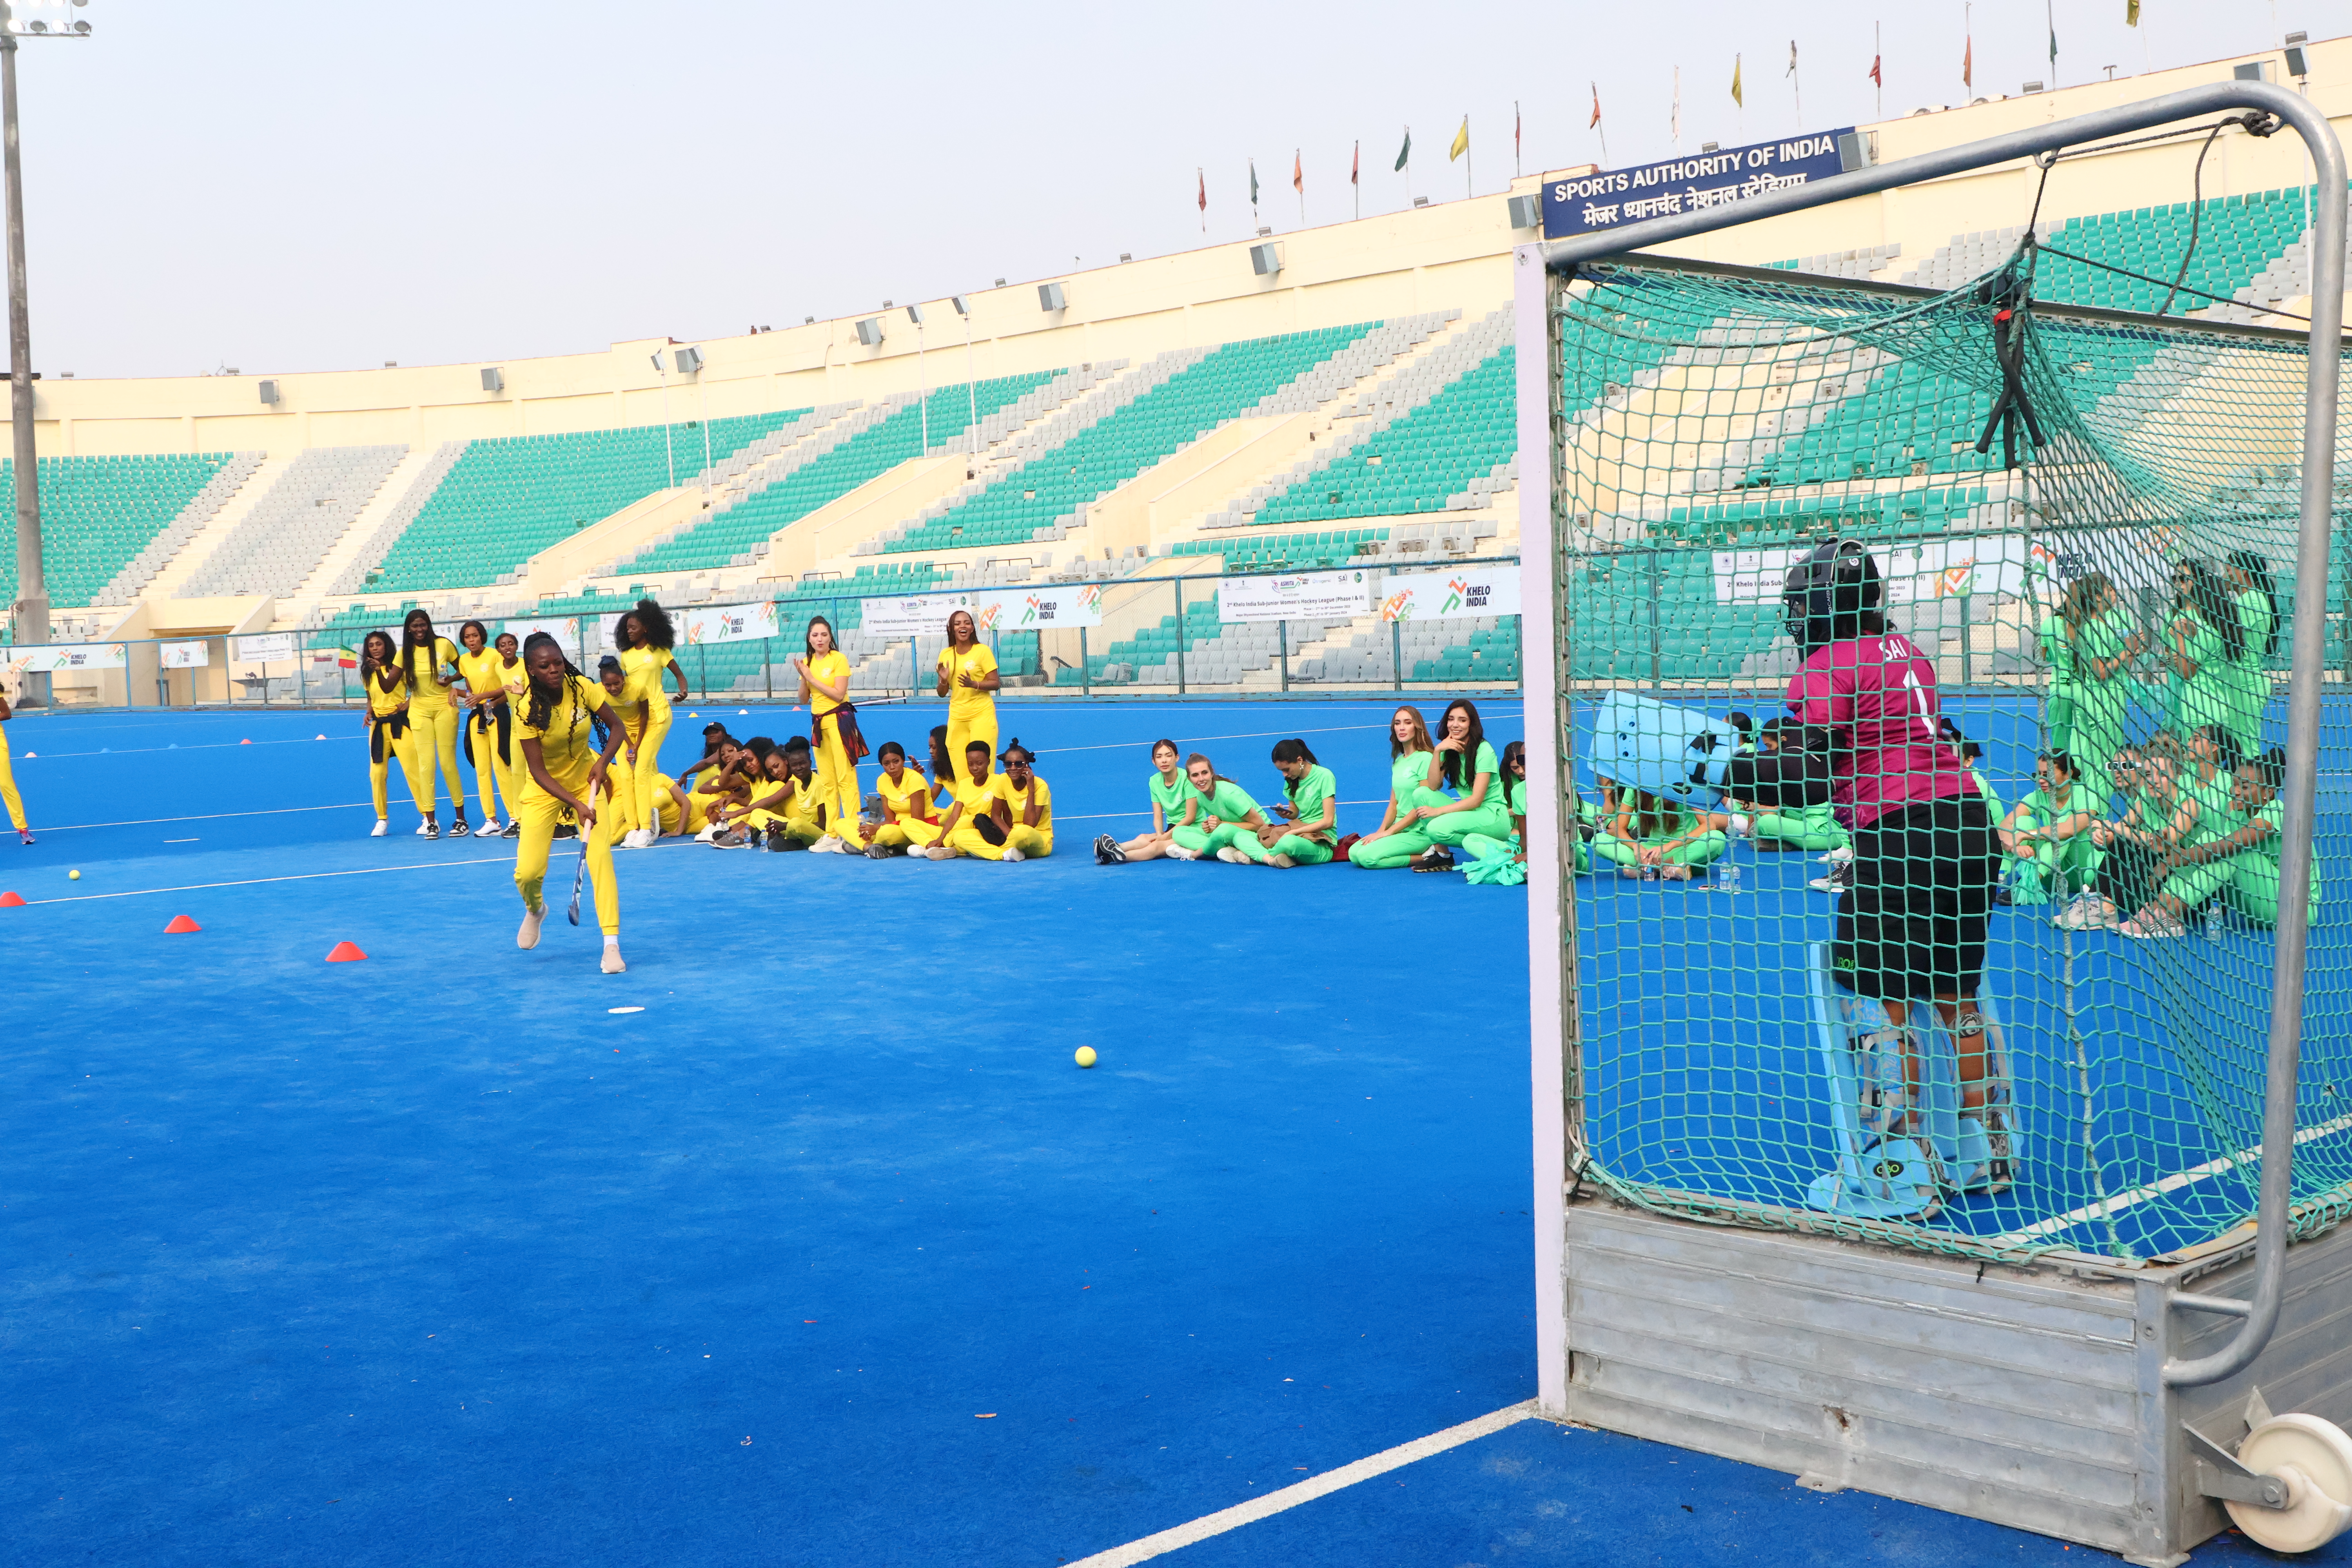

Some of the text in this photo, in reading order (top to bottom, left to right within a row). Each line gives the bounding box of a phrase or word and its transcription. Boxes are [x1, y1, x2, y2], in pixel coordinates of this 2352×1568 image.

[1555, 135, 1835, 202] SPORTS AUTHORITY OF INDIA
[1582, 201, 1619, 227] मेजर
[1623, 192, 1682, 218] ध्यानचंद
[1684, 186, 1739, 210] नेशनल
[1467, 586, 1490, 596] KHELO
[1040, 602, 1056, 610] KHELO
[1466, 597, 1487, 607] INDIA
[1039, 611, 1054, 619] INDIA
[1878, 639, 1907, 661] SAI
[1902, 670, 1934, 739] 1
